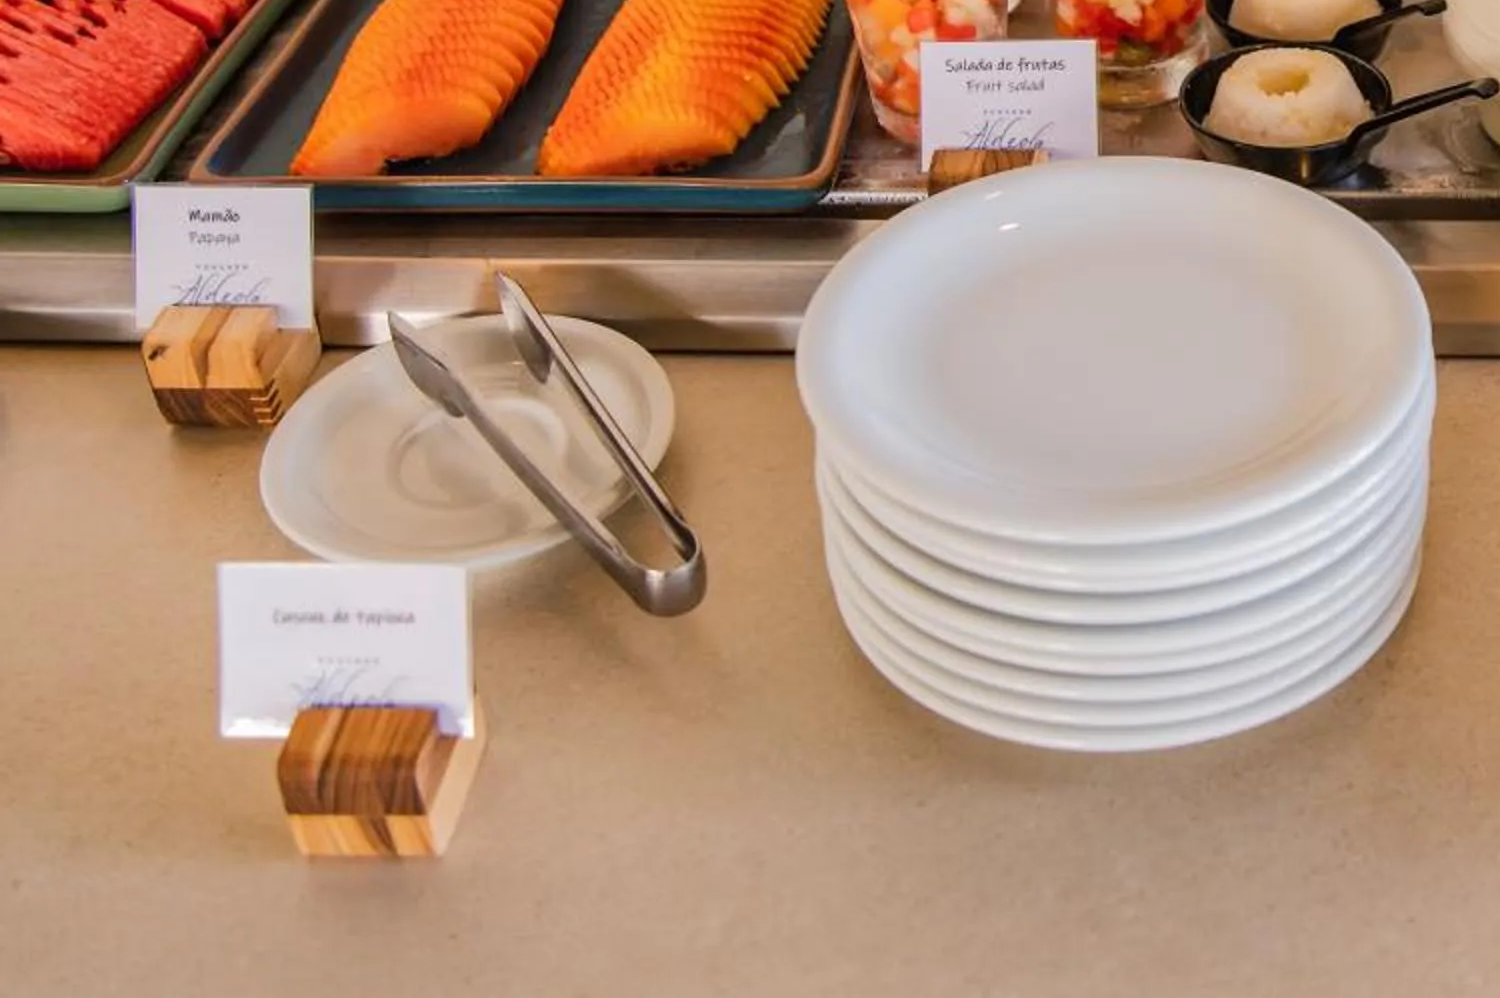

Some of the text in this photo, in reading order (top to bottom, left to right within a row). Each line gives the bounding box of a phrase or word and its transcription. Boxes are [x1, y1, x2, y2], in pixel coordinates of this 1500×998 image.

[945, 57, 1066, 75] Salada de frutas
[965, 78, 1045, 94] Fruit salad
[188, 208, 241, 223] Mamão
[188, 231, 241, 247] Papaya
